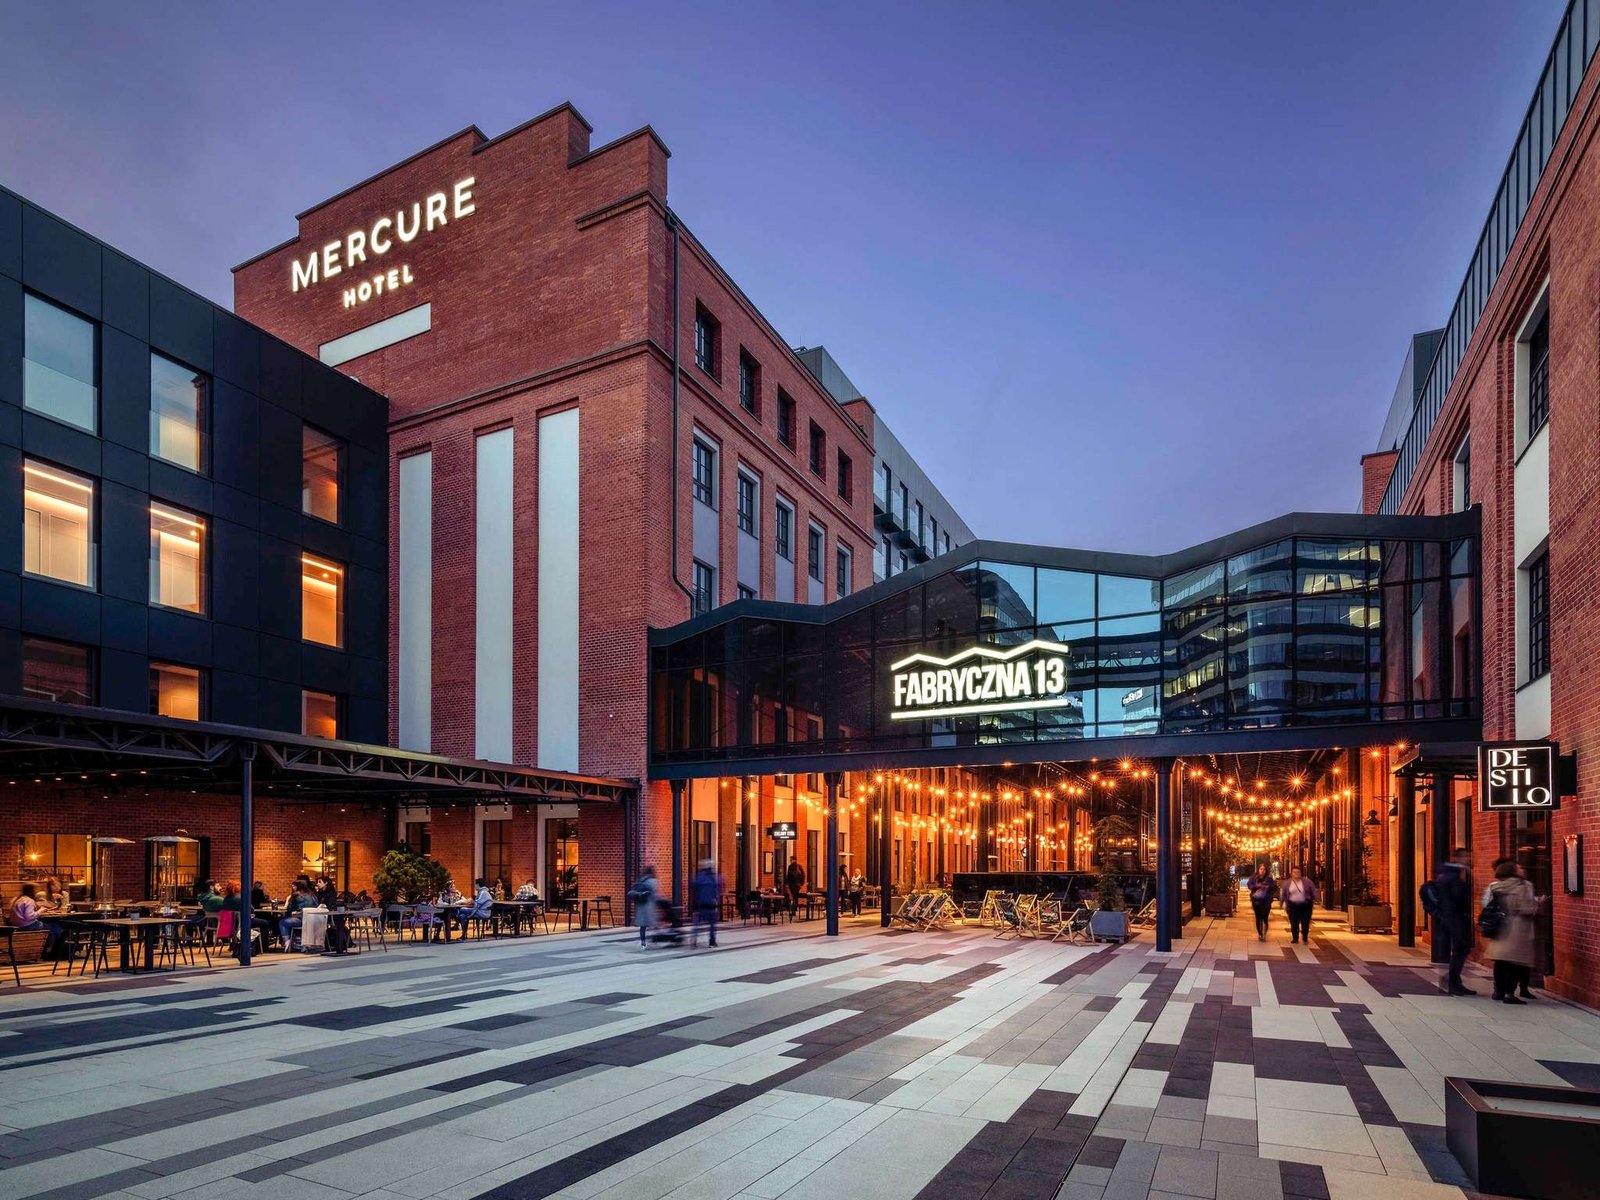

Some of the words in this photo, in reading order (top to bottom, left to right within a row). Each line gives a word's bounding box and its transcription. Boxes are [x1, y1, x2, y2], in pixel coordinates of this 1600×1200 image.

[292, 176, 476, 293] MERCURE
[343, 265, 414, 308] HOTEL
[894, 660, 1032, 706] FABRYCZNA
[1034, 658, 1065, 694] 13
[1491, 749, 1528, 768] DE
[1490, 768, 1531, 787] STI
[1512, 787, 1551, 806] LO
